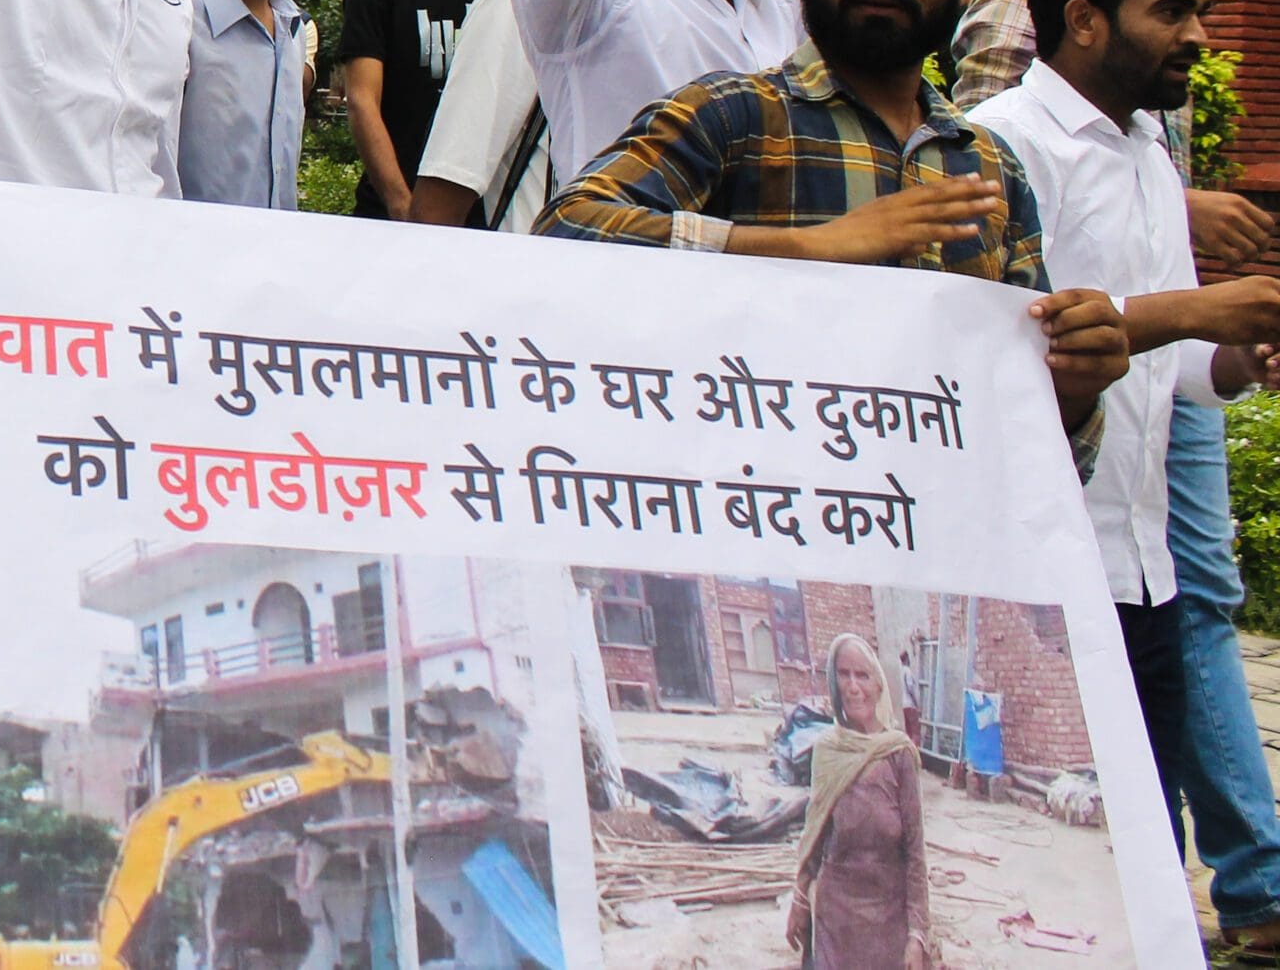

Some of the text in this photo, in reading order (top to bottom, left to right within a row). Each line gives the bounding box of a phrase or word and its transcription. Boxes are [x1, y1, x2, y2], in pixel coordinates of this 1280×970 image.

[128, 306, 183, 385] में
[198, 331, 498, 416] मुसलमानों
[512, 337, 576, 412] के
[590, 363, 674, 422] घर
[693, 355, 795, 432] और
[806, 374, 964, 461] दुकानों
[36, 415, 917, 552] को बुलडोज़र से गिराना बंद करो
[240, 775, 299, 812] JCB
